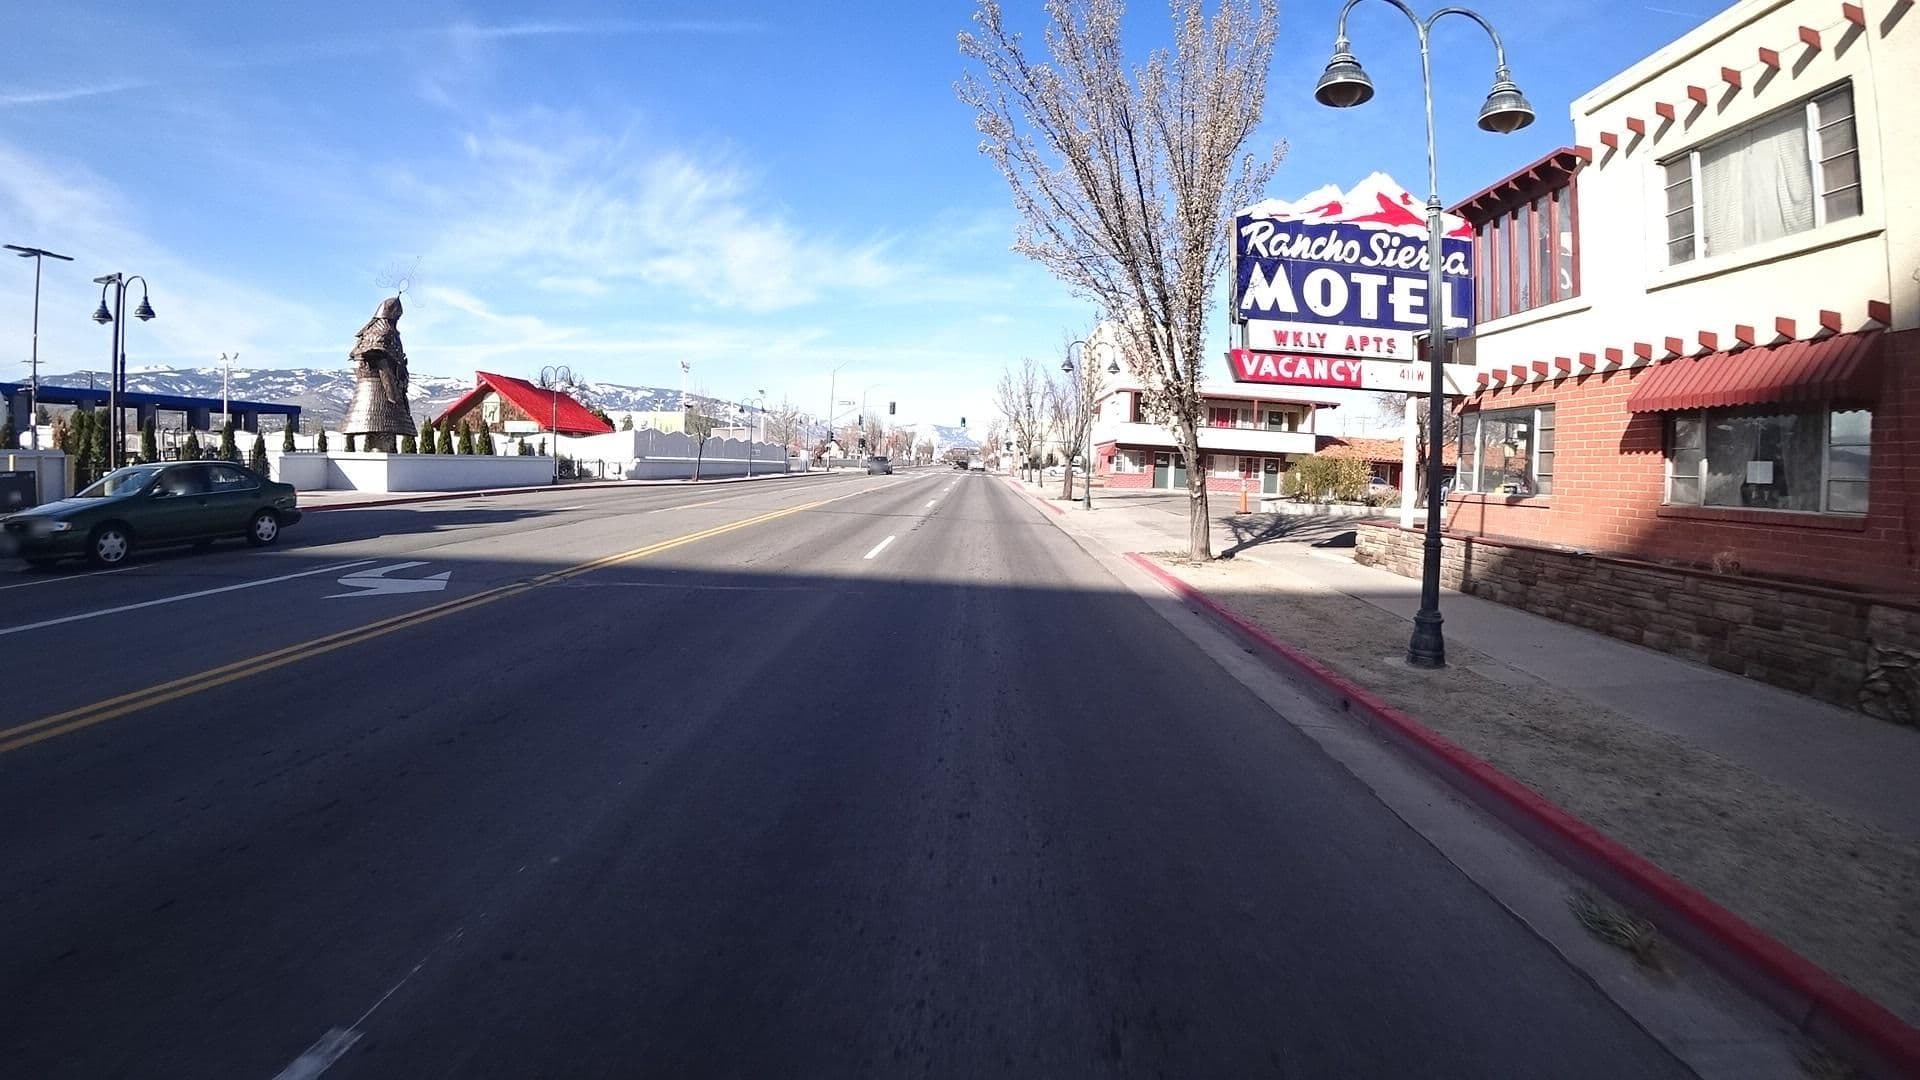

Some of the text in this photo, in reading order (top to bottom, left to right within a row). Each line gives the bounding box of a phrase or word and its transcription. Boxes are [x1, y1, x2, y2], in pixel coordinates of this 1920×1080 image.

[1240, 221, 1361, 264] Rancho
[1240, 261, 1469, 329] MOTEL
[1273, 330, 1396, 353] WKLY APTS
[1240, 355, 1363, 382] VACANCY
